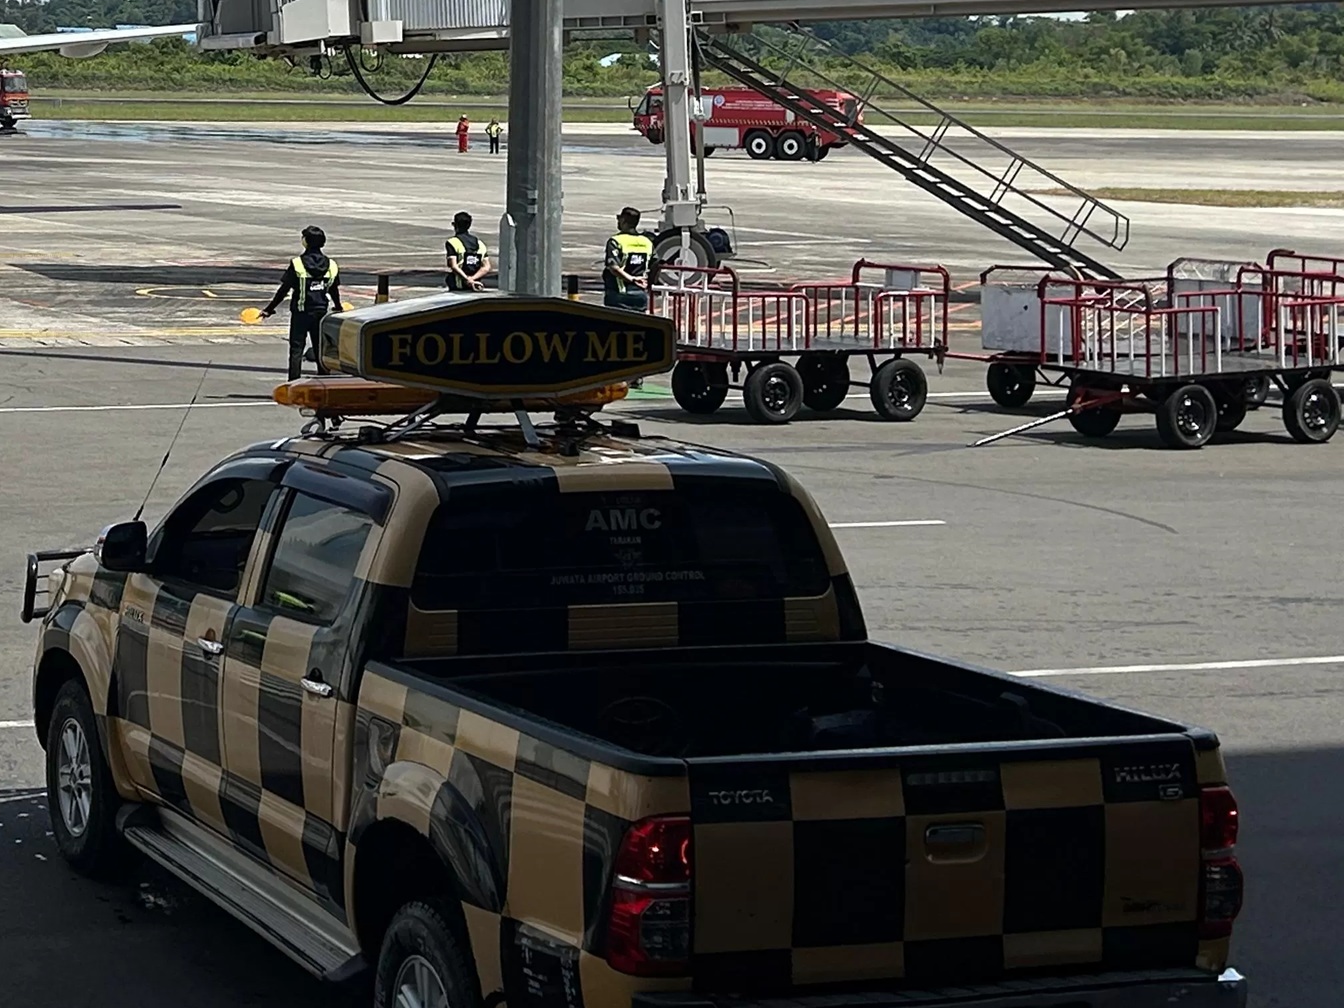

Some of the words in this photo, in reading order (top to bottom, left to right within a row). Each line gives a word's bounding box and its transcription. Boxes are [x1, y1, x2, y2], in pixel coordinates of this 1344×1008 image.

[388, 331, 576, 366] FOLLOW
[582, 330, 648, 364] ME
[584, 507, 662, 531] AMC
[587, 573, 624, 583] AIRPORT
[626, 572, 663, 582] GROUND
[665, 570, 704, 582] CONTROL
[1114, 763, 1182, 783] HILUX
[708, 789, 774, 805] TOYOTA
